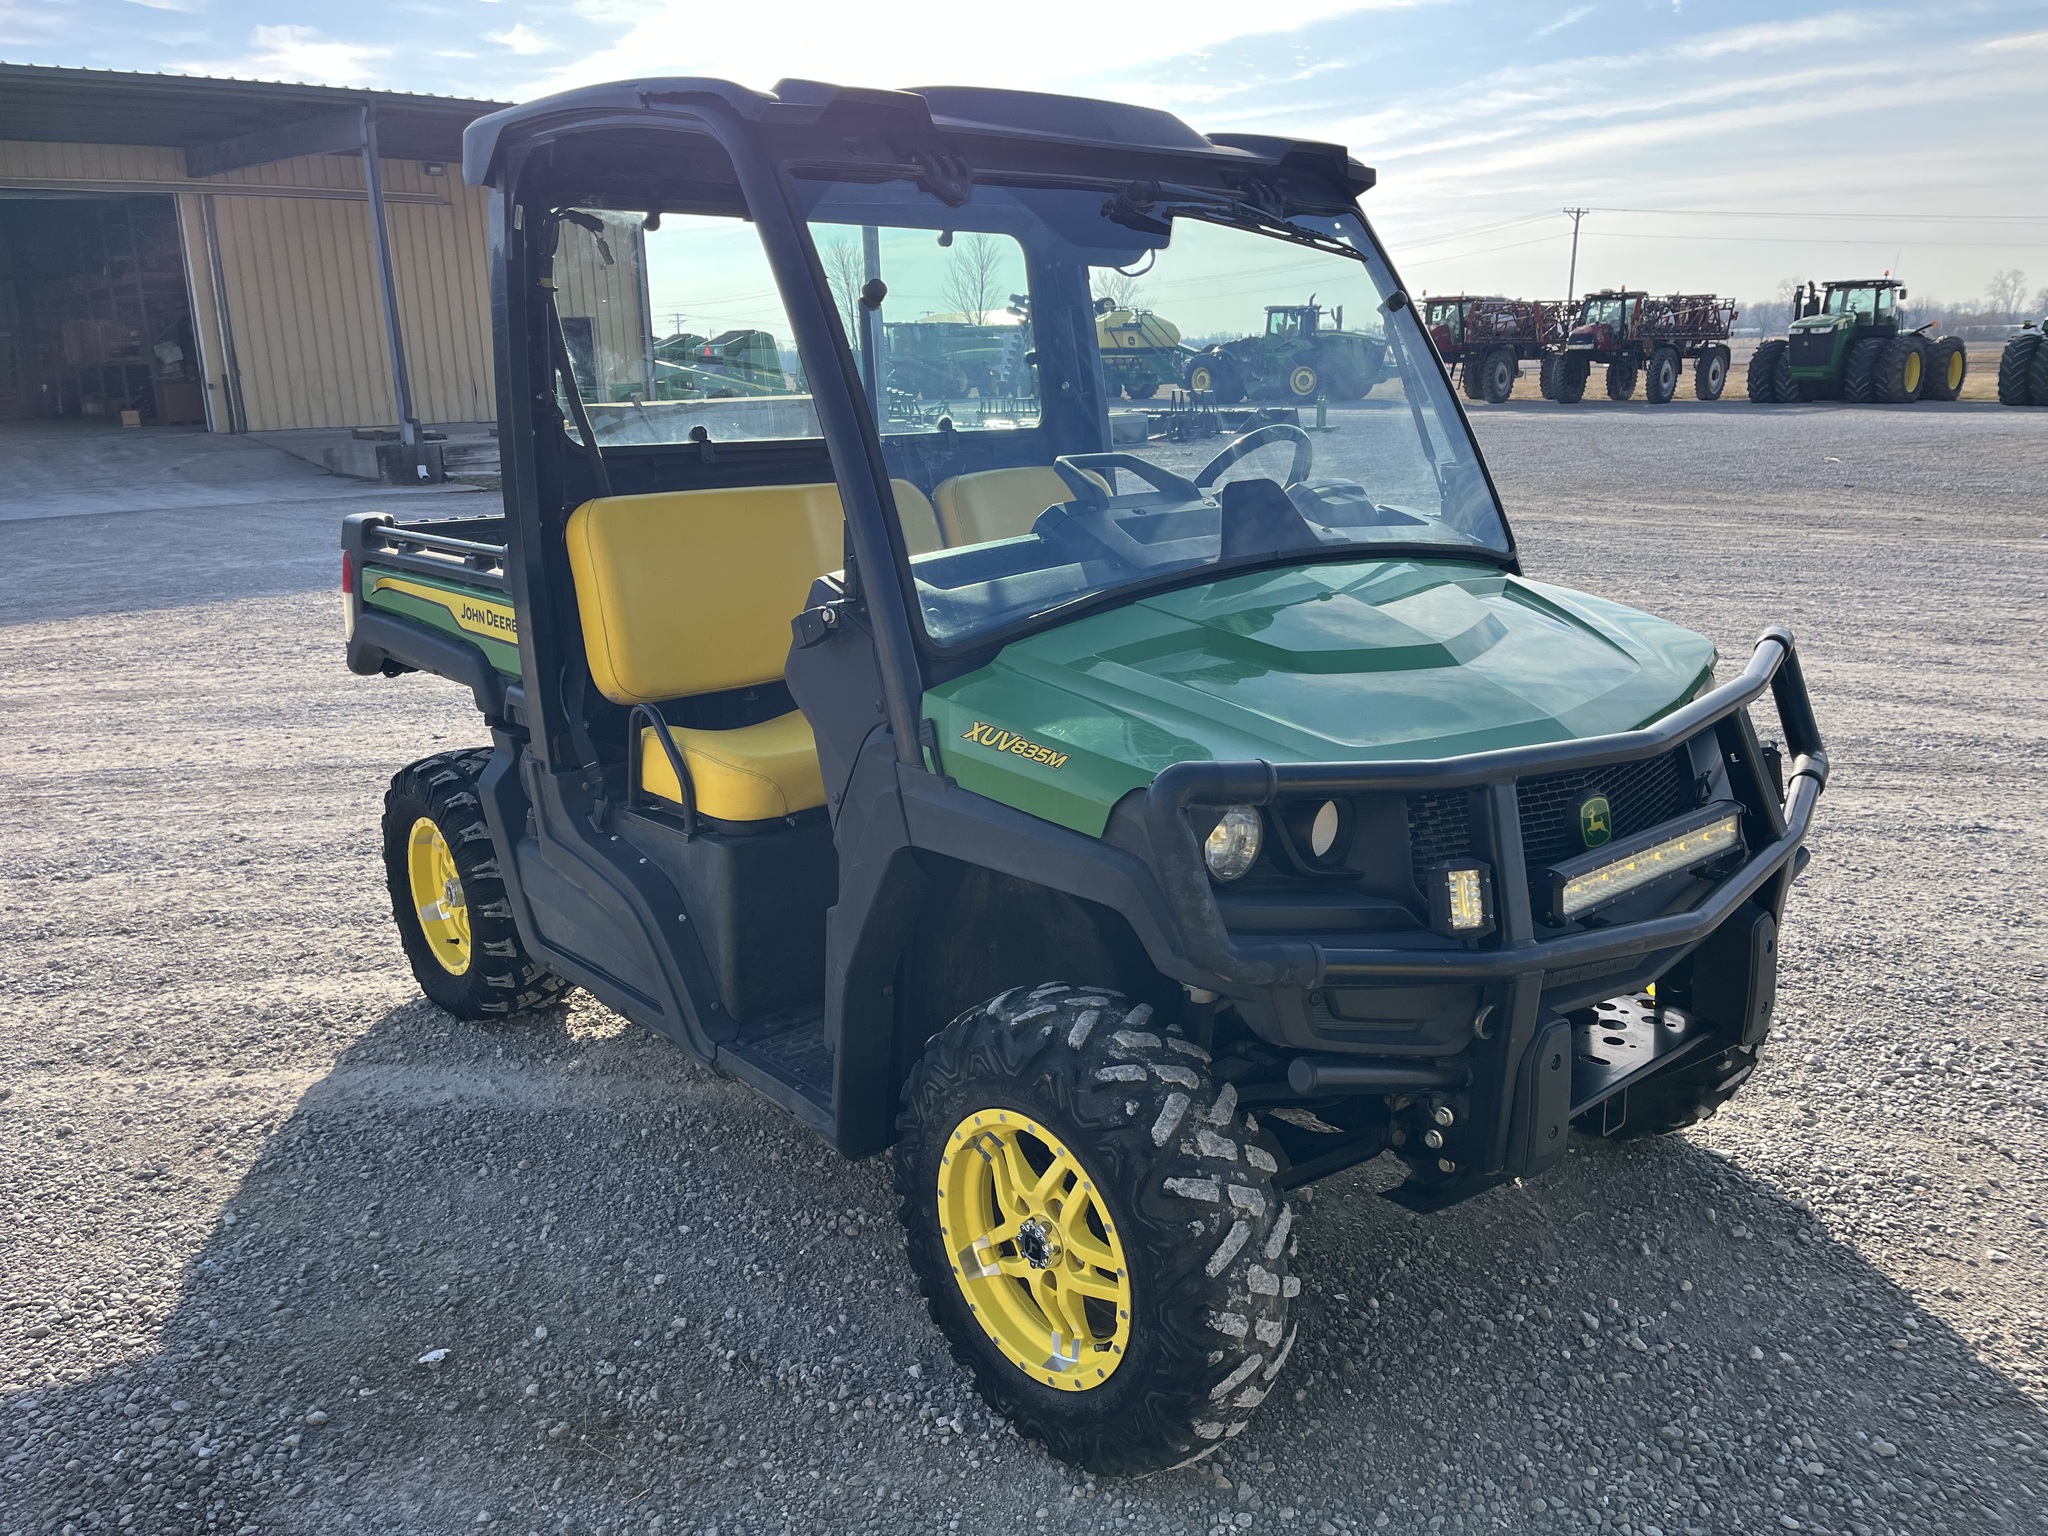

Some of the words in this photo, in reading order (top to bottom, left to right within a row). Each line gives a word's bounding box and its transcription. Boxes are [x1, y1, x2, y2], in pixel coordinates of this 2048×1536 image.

[461, 603, 485, 624] JOHN
[486, 609, 517, 633] DEERE
[960, 720, 1071, 769] XUV835M
